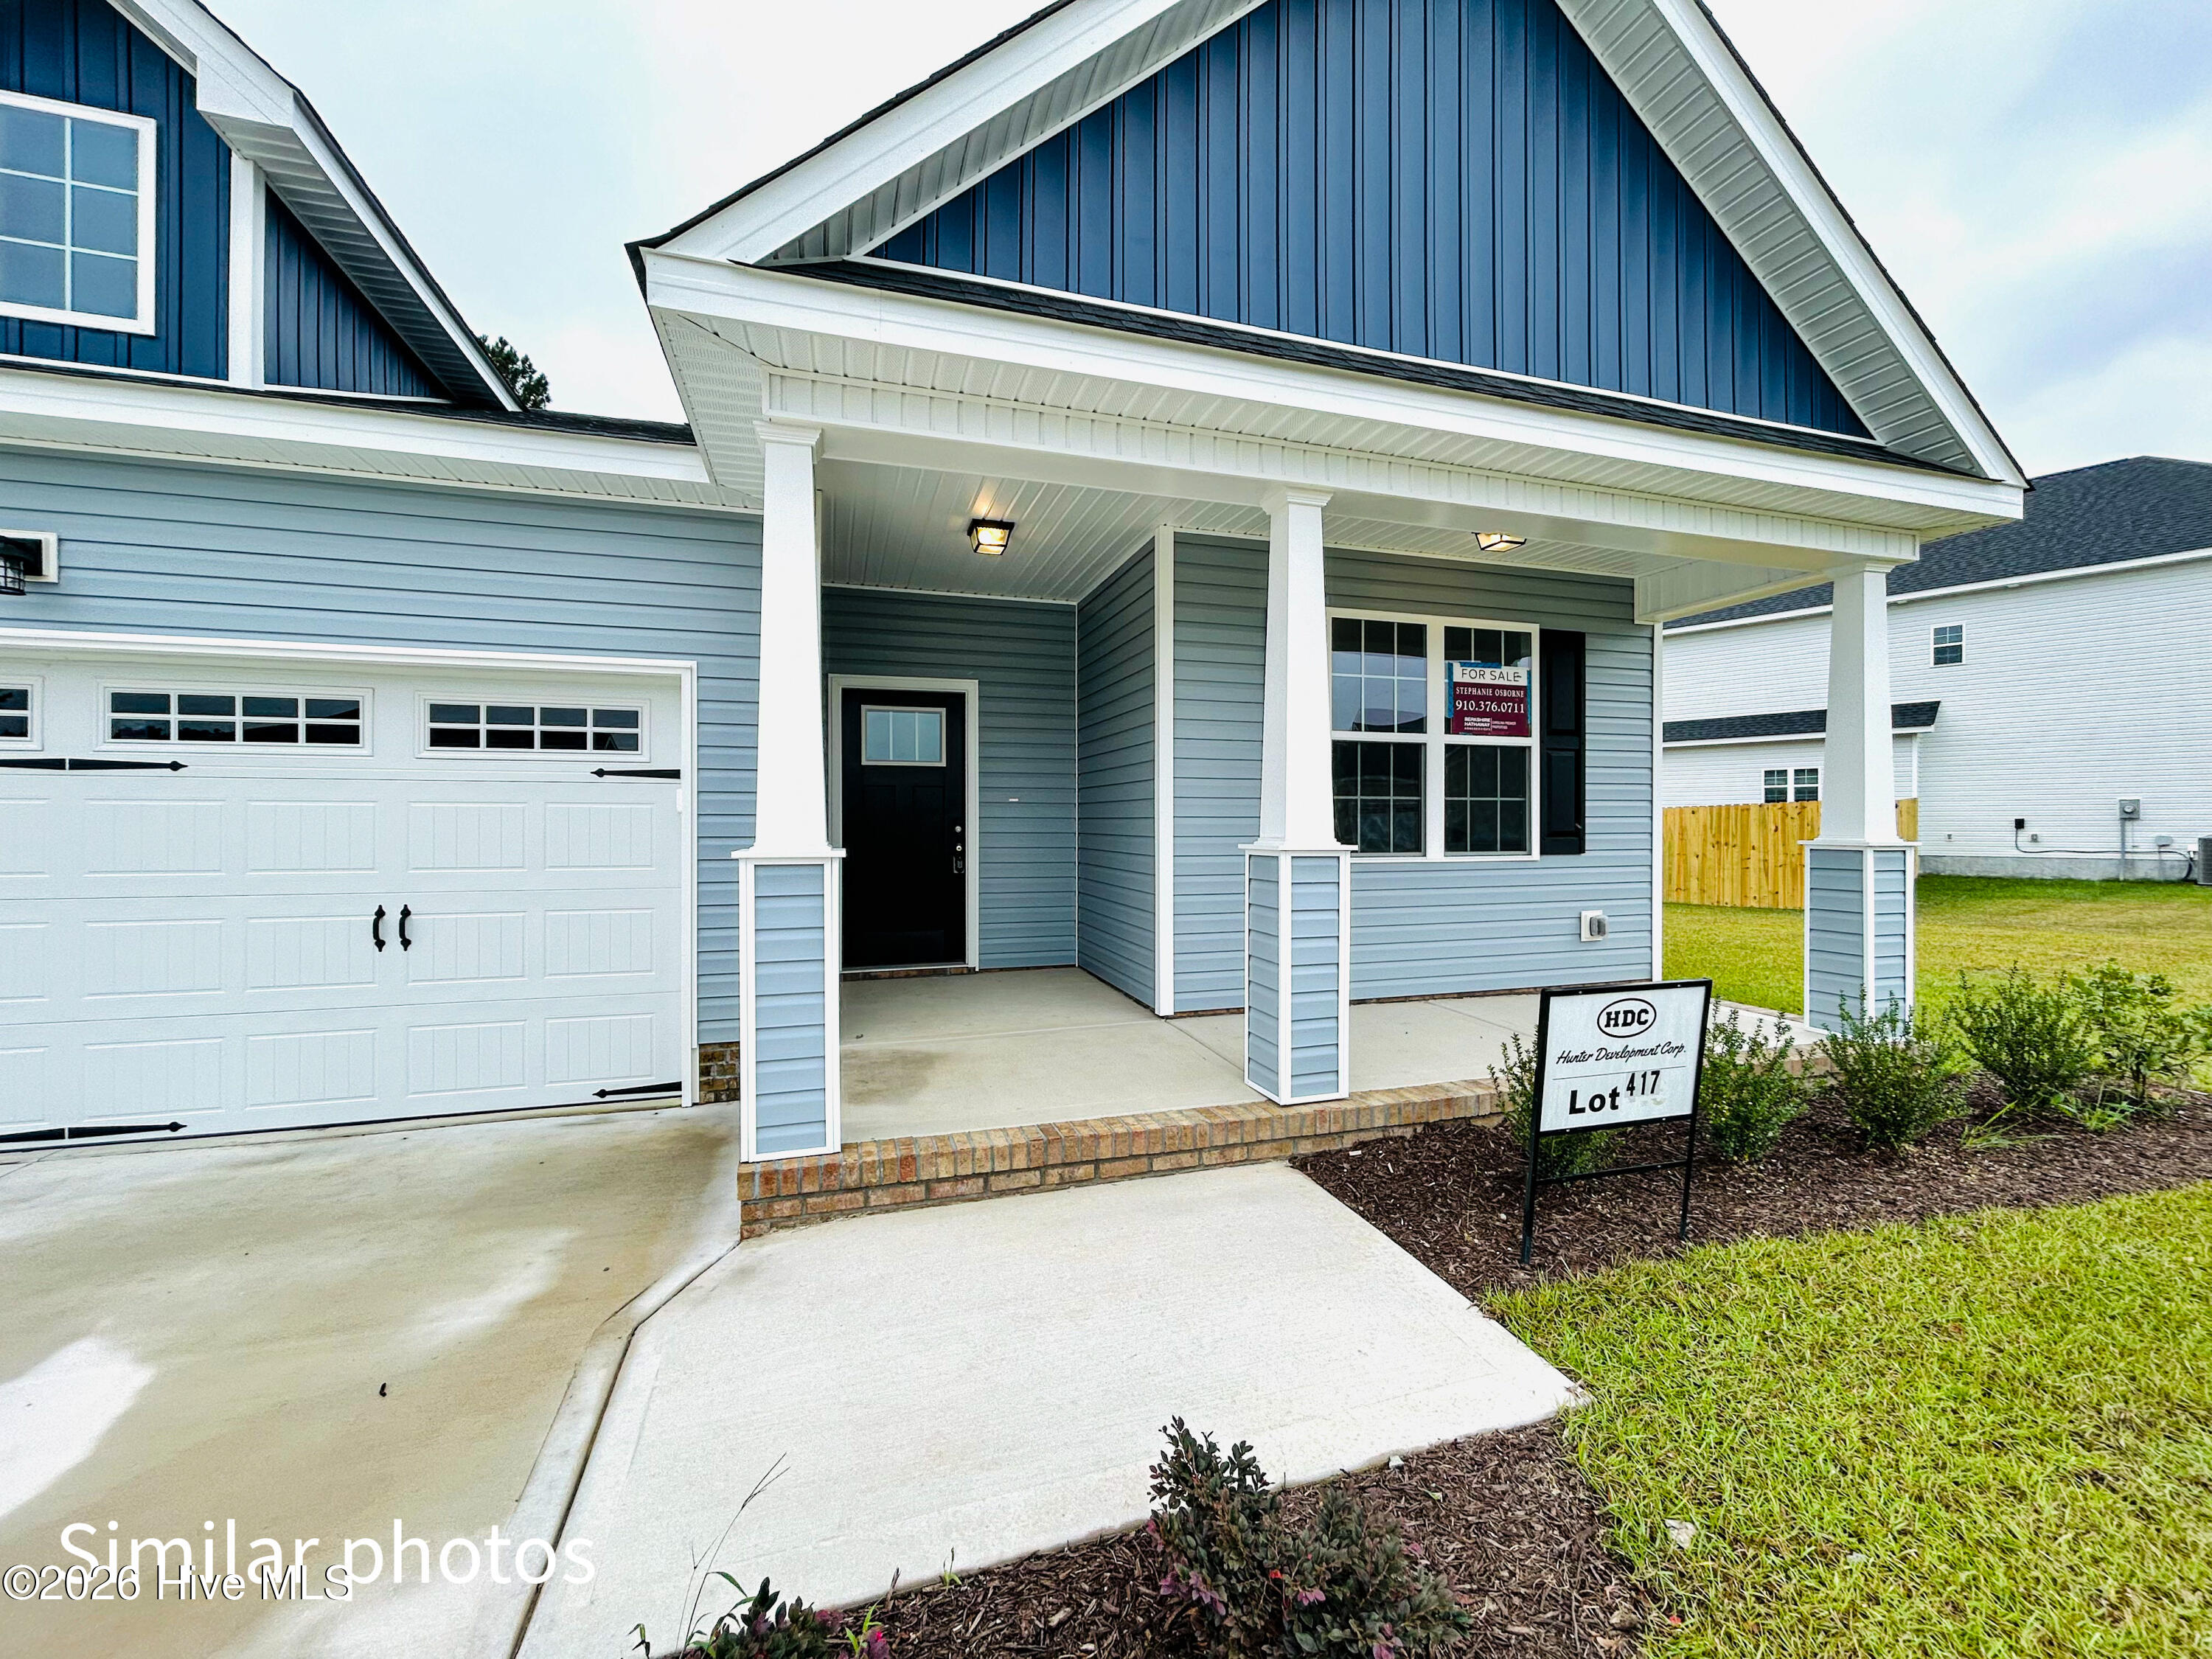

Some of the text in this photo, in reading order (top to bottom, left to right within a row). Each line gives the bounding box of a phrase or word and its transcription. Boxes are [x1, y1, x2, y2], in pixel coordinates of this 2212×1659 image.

[1461, 668, 1522, 682] FOR SALE
[1455, 686, 1524, 698] STEPHANIE OSBORNE
[1455, 700, 1525, 714] 910.376.0711
[1604, 1008, 1649, 1029] HDC
[1556, 1041, 1686, 1065] Hunter Development Corp.
[1568, 1070, 1660, 1115] Lot 417
